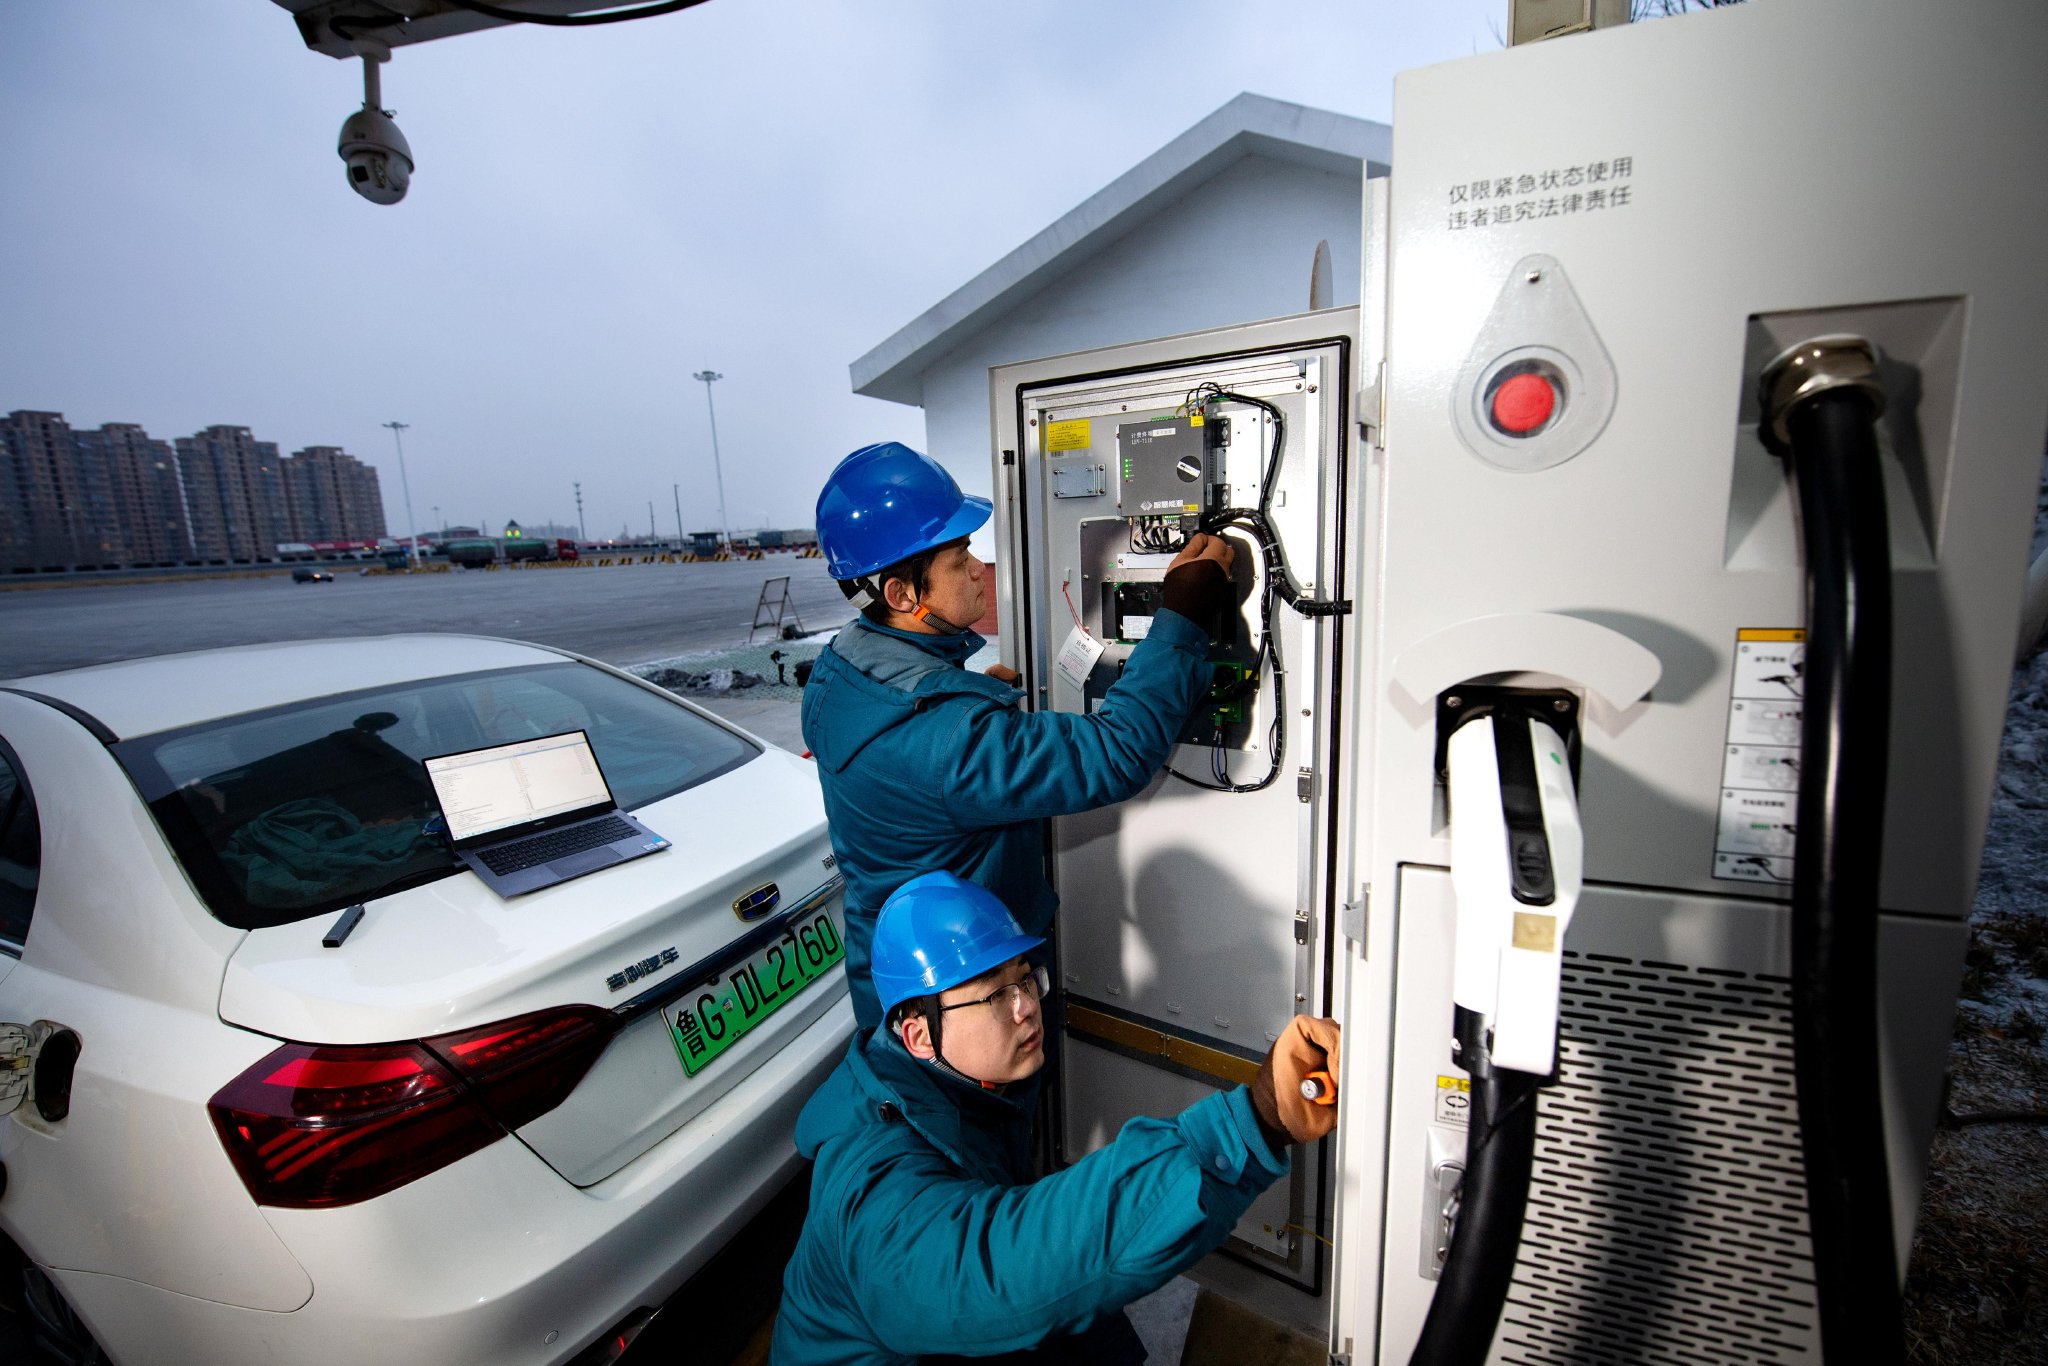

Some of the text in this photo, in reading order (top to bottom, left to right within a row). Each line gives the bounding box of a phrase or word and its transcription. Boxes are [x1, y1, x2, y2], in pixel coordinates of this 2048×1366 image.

[1448, 156, 1633, 205] 仅限紧急状态使用
[1448, 185, 1632, 231] 违者追究法律责任
[604, 946, 680, 993] 吉利汽车
